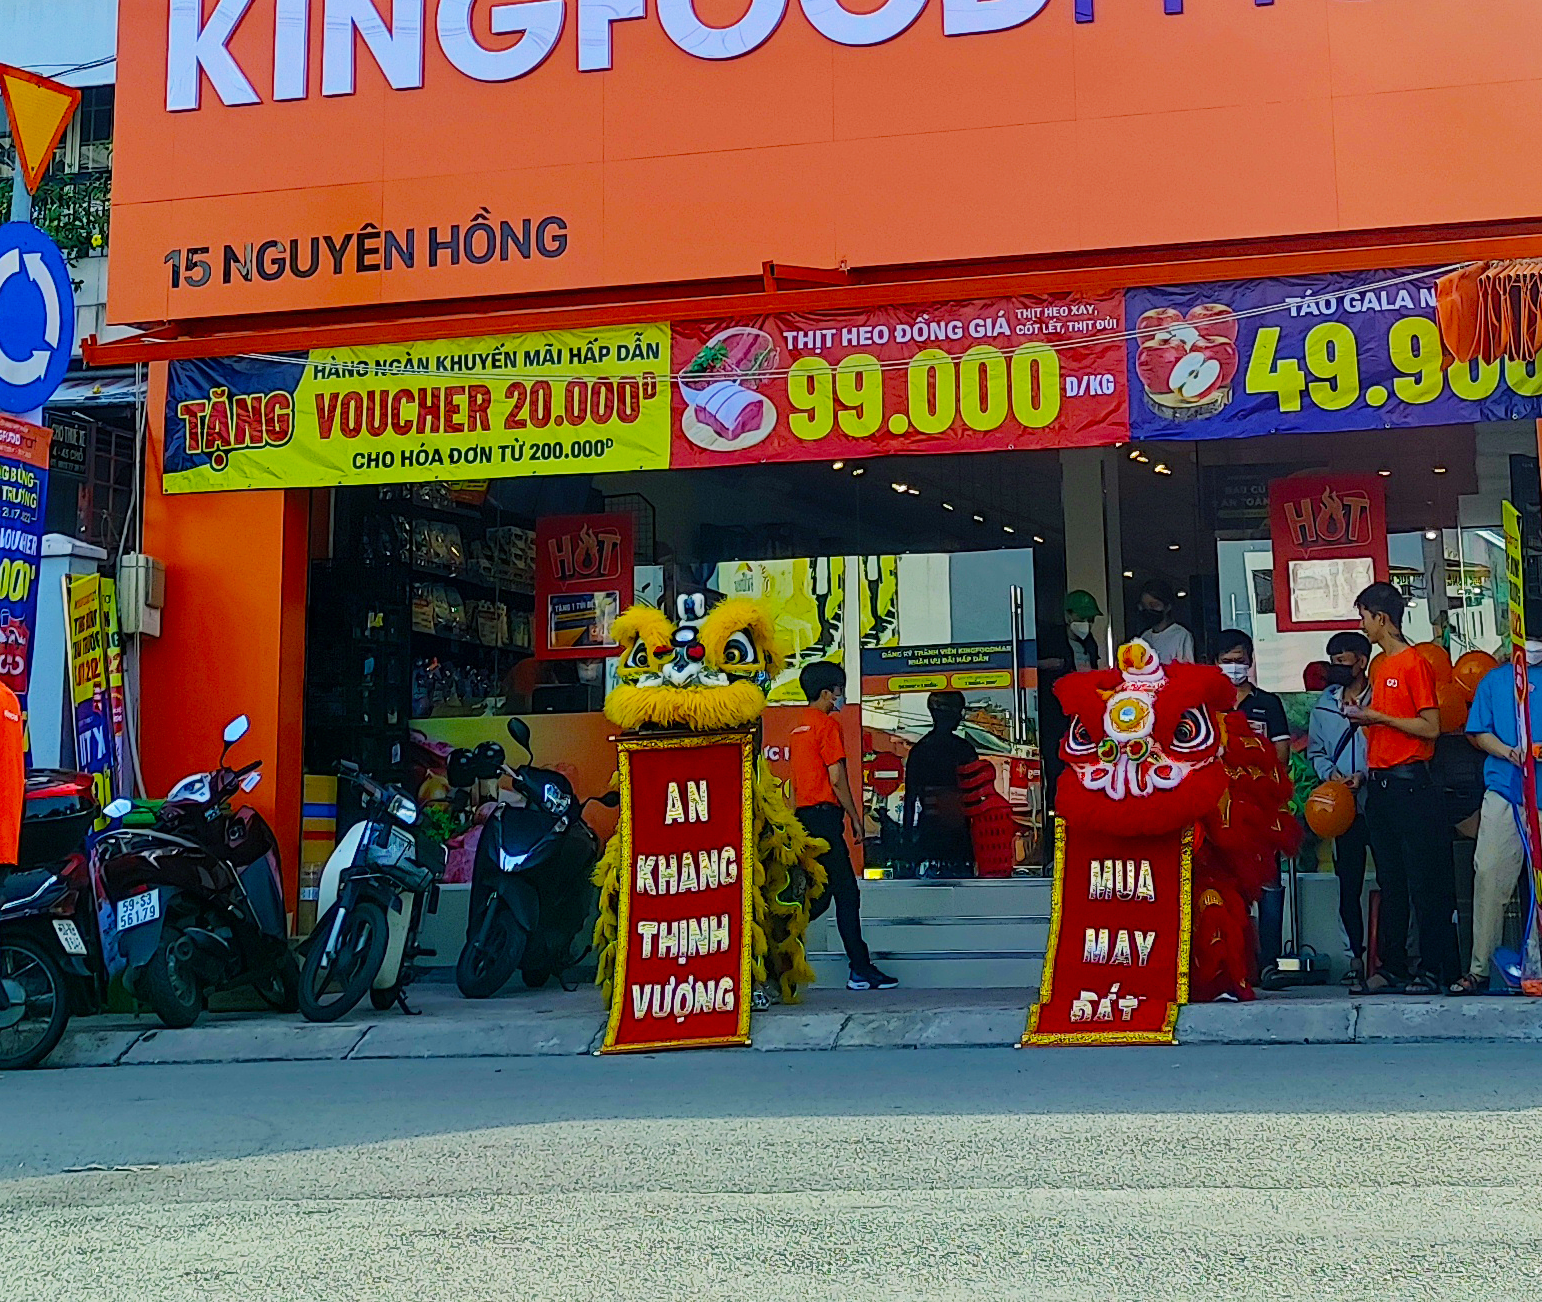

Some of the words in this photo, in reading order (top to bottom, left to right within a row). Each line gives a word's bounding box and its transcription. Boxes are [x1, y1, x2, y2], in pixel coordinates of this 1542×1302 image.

[164, 246, 212, 289] 15
[222, 222, 415, 287] NGUYÊN
[428, 207, 568, 270] HỒNG
[1016, 309, 1043, 323] THỊT
[1045, 307, 1068, 318] HEO
[1016, 317, 1040, 335] CỐT
[1067, 319, 1094, 334] THỊT
[1286, 288, 1338, 319] TÁO
[1343, 289, 1415, 314] GALA
[783, 330, 837, 354] THỊT
[841, 326, 889, 347] HEO
[895, 313, 962, 344] ĐỒNG
[966, 310, 1010, 338] GIÁ
[313, 355, 369, 380] HÀNG
[374, 352, 430, 377] NGÀN
[436, 343, 517, 373] KHUYẾN
[523, 346, 562, 368] MÃI
[569, 335, 611, 365] HẤP
[618, 332, 660, 363] DẪN
[315, 385, 490, 441] VOUCHER
[787, 341, 1060, 441] 99.000
[178, 387, 295, 472] TẶNG
[352, 450, 395, 471] CHO
[401, 442, 444, 469] HÓA
[448, 443, 492, 466] ĐƠN
[499, 436, 525, 464] TỪ
[1284, 485, 1370, 544] HOT
[548, 523, 621, 577] HOT
[664, 780, 709, 824] AN
[637, 845, 738, 896] KHANG
[1088, 859, 1156, 902] MUA
[121, 905, 155, 927] 561.79
[123, 893, 151, 913] 59-S3
[638, 914, 730, 965] THỊNH
[1082, 928, 1156, 967] MAY
[632, 975, 735, 1023] VƯỢNG
